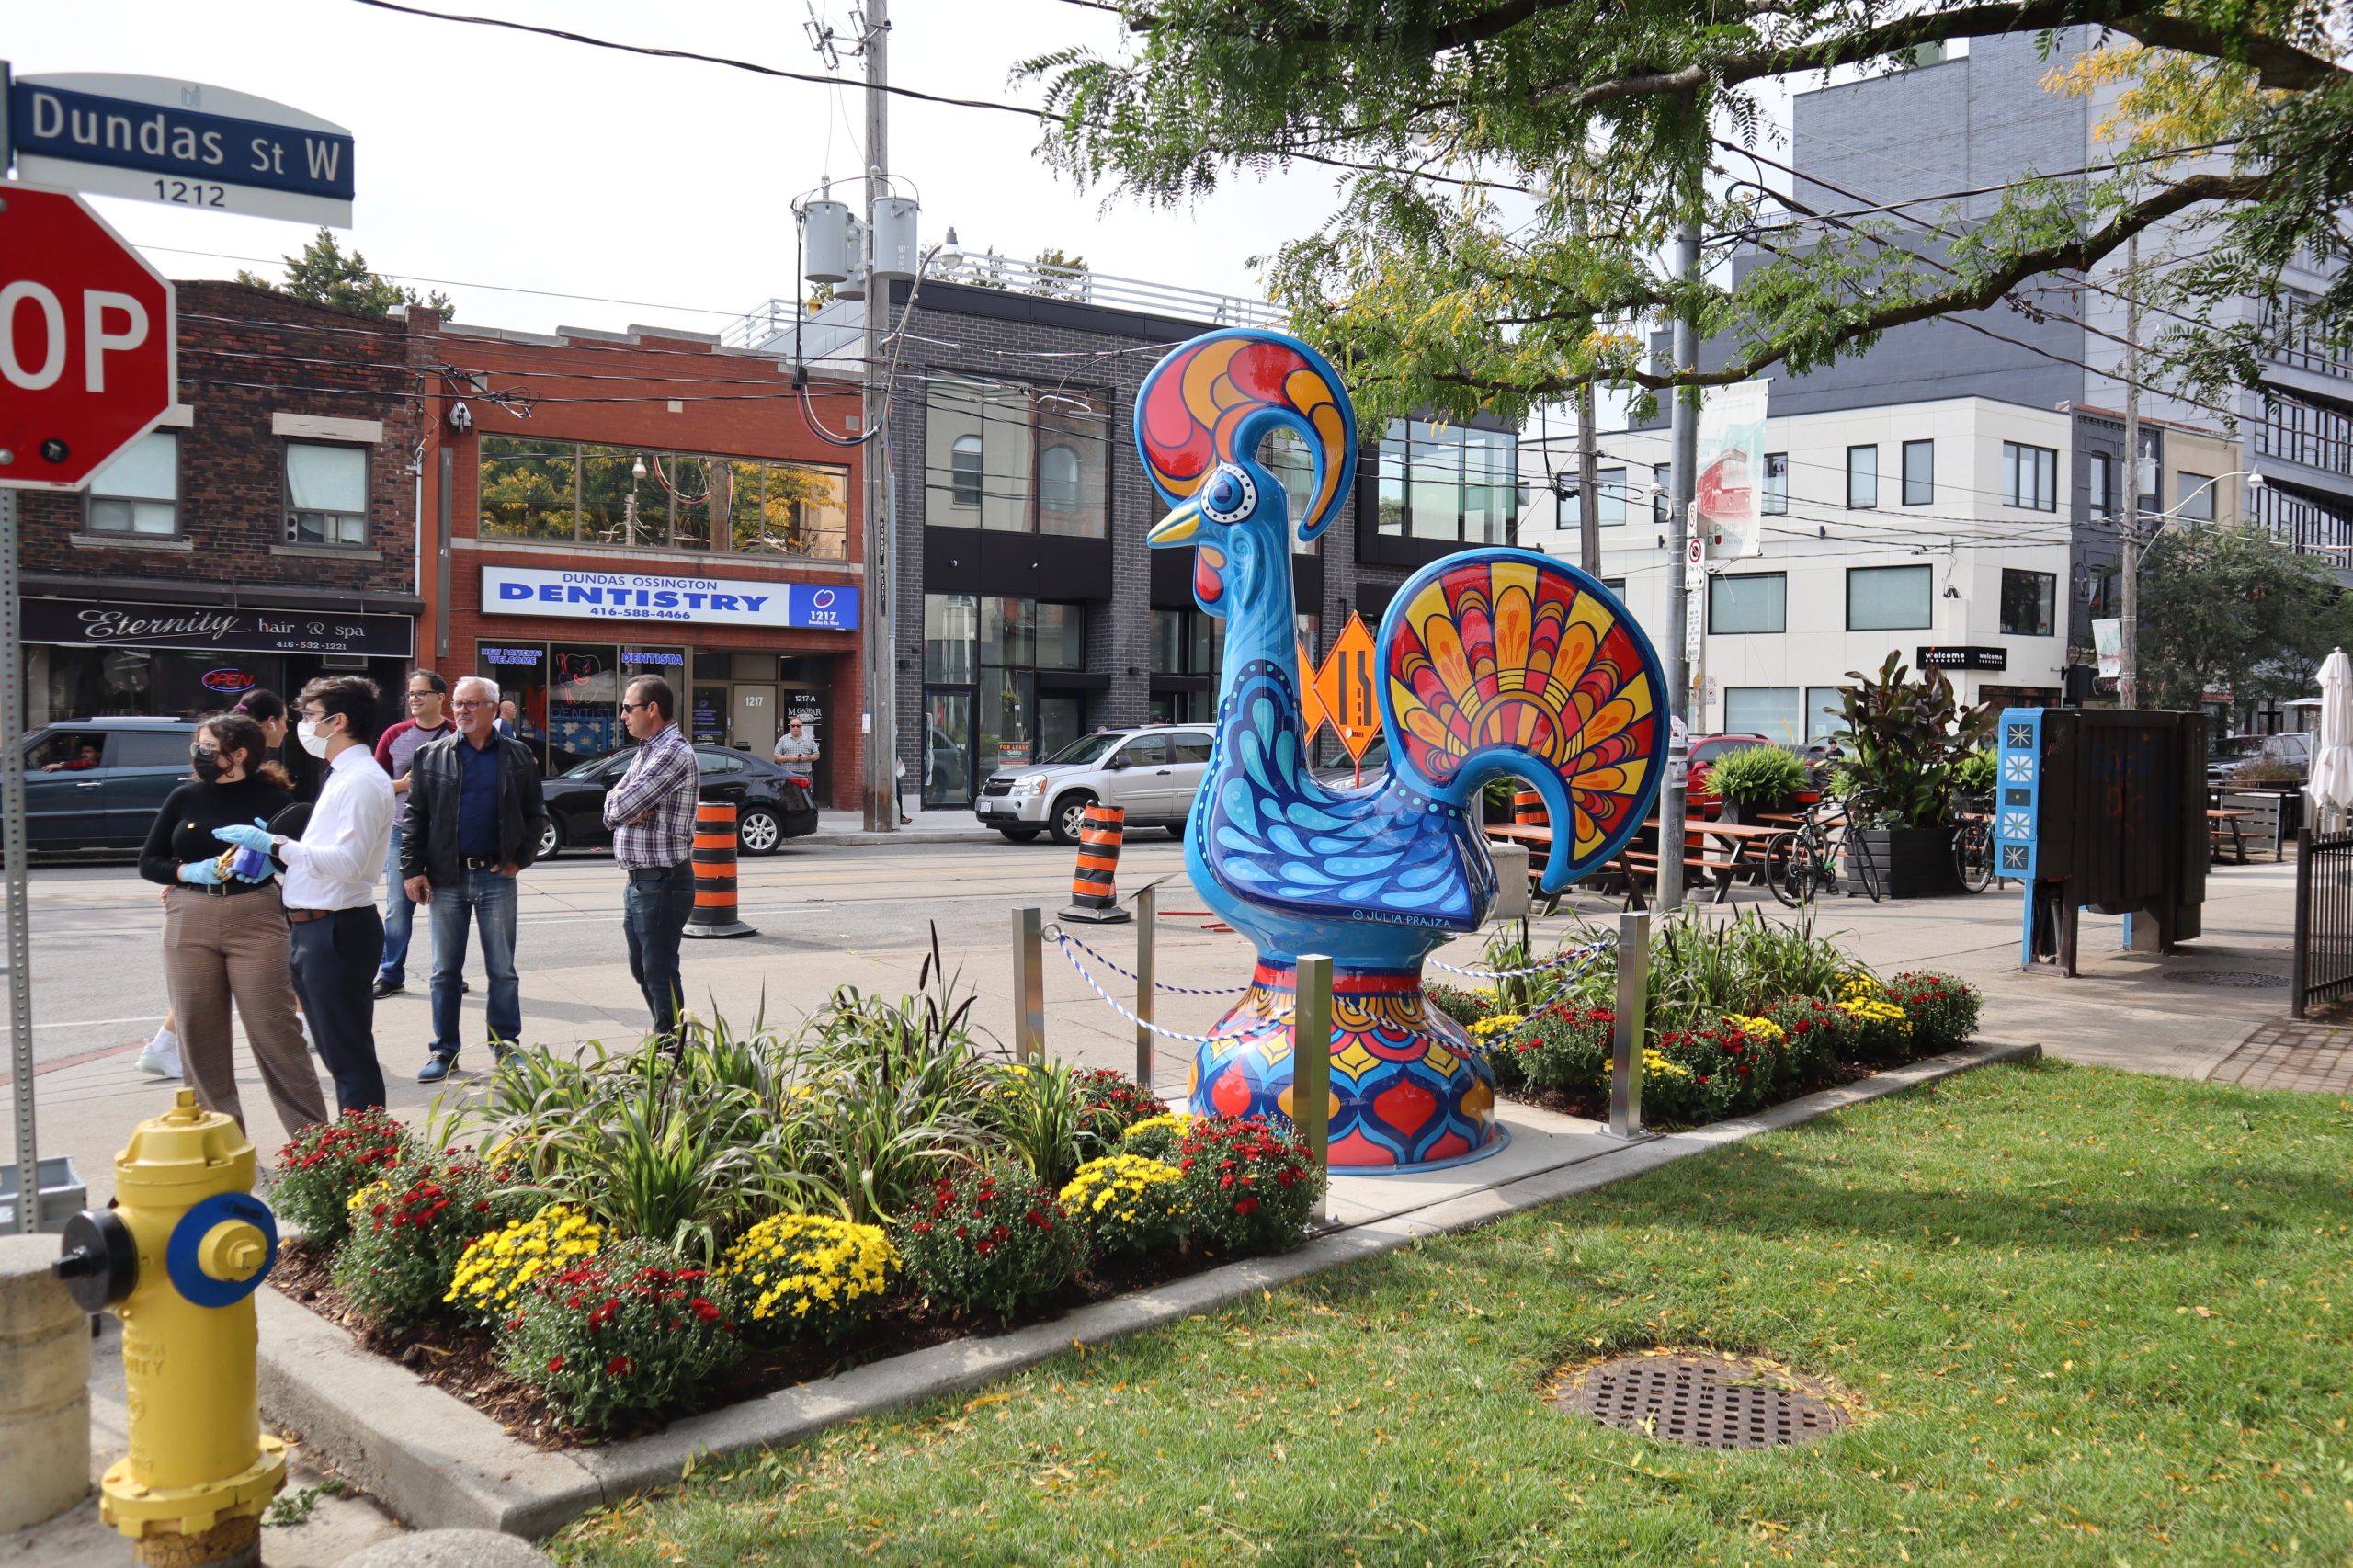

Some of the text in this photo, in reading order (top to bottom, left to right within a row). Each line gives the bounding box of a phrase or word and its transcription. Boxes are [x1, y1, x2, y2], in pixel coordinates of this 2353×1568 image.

[32, 93, 339, 182] Dundas St W
[154, 179, 225, 208] 1212
[563, 573, 717, 591] DUNDAS OSSINGTON
[499, 582, 769, 612] DENTISTRY
[590, 607, 690, 619] 416-588-4466
[810, 610, 837, 621] 1217
[77, 609, 366, 642] Eternity hair & spa
[481, 647, 543, 658] NEW PATIENTS
[621, 652, 683, 665] DENTISTA
[488, 655, 537, 665] WELCOME
[203, 672, 256, 687] OPEN
[745, 696, 764, 707] 1217
[551, 707, 612, 720] DENTIST
[1366, 911, 1403, 924] JULIA
[1406, 915, 1452, 928] PRAJZA
